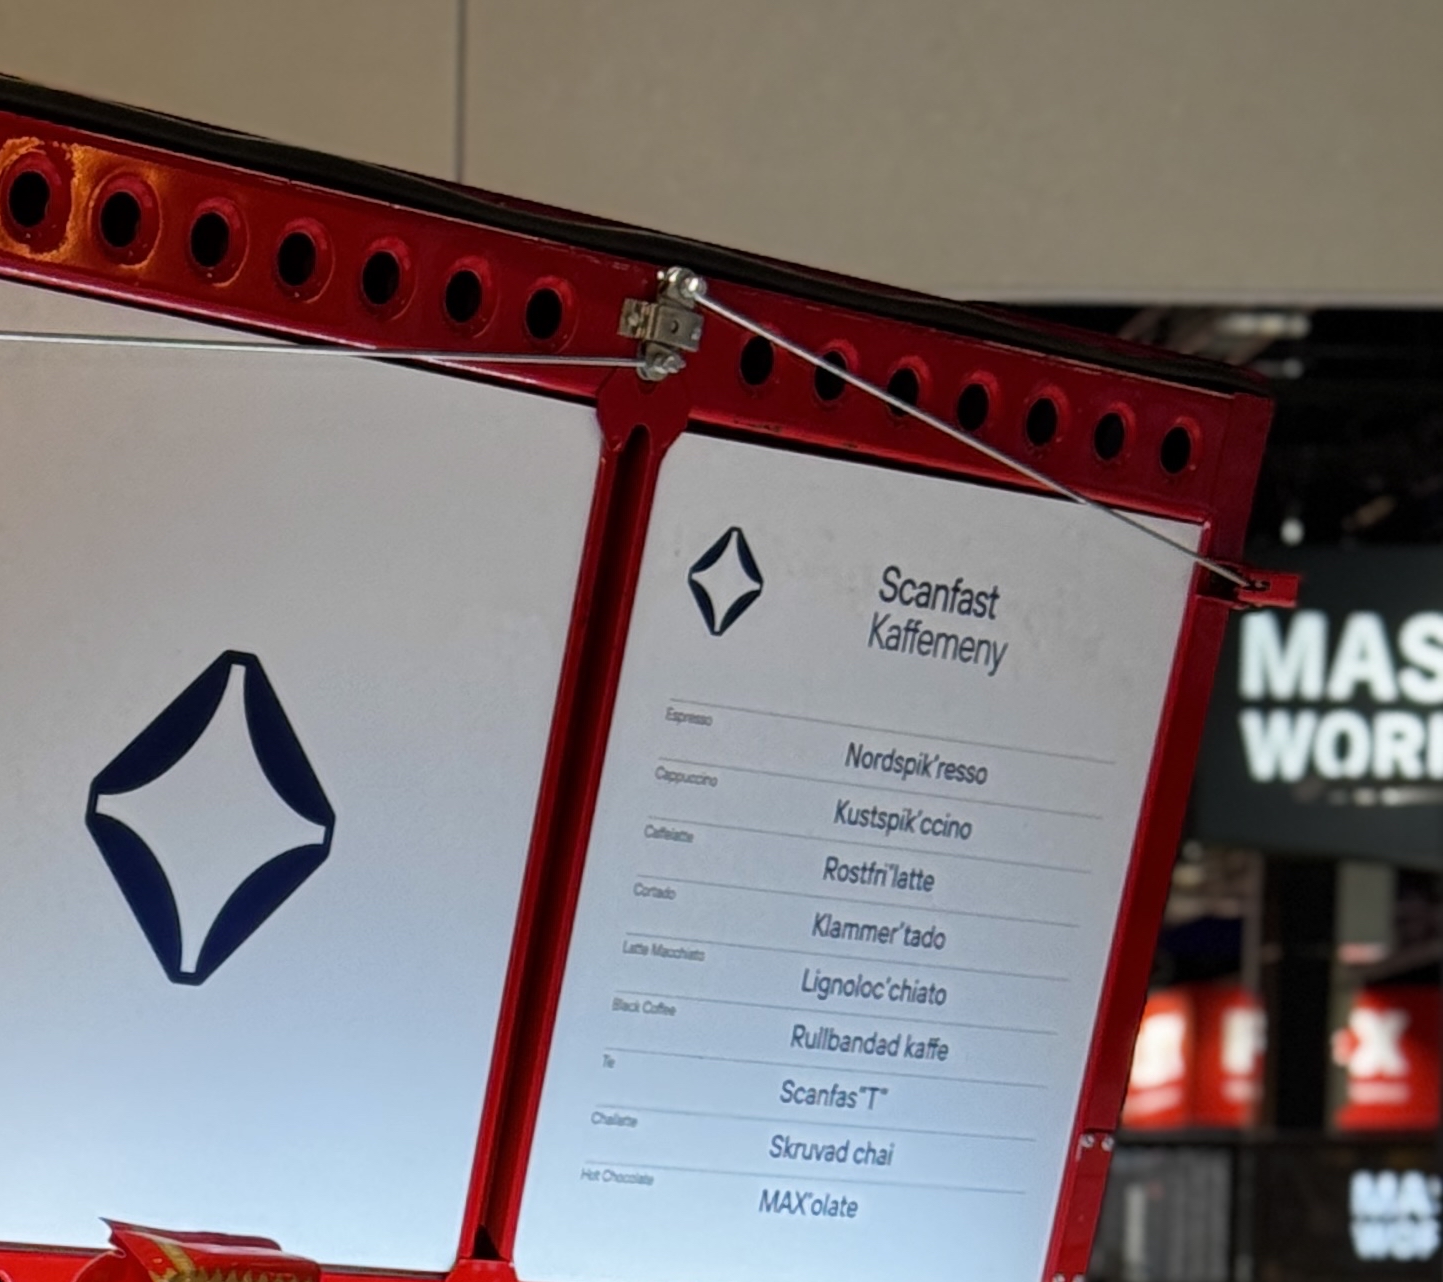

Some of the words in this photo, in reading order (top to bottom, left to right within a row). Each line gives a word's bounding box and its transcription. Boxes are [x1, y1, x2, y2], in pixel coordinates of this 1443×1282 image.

[879, 565, 1000, 620] Scanfast
[868, 611, 1008, 677] Kaffemeny
[665, 707, 713, 726] Espresso
[655, 766, 718, 787] Cappuccino
[633, 882, 676, 900] Cortado
[790, 1024, 901, 1057] Rullbandad
[904, 1034, 949, 1061] kaffe
[769, 1134, 850, 1163] Skruvad
[853, 1141, 895, 1166] chai
